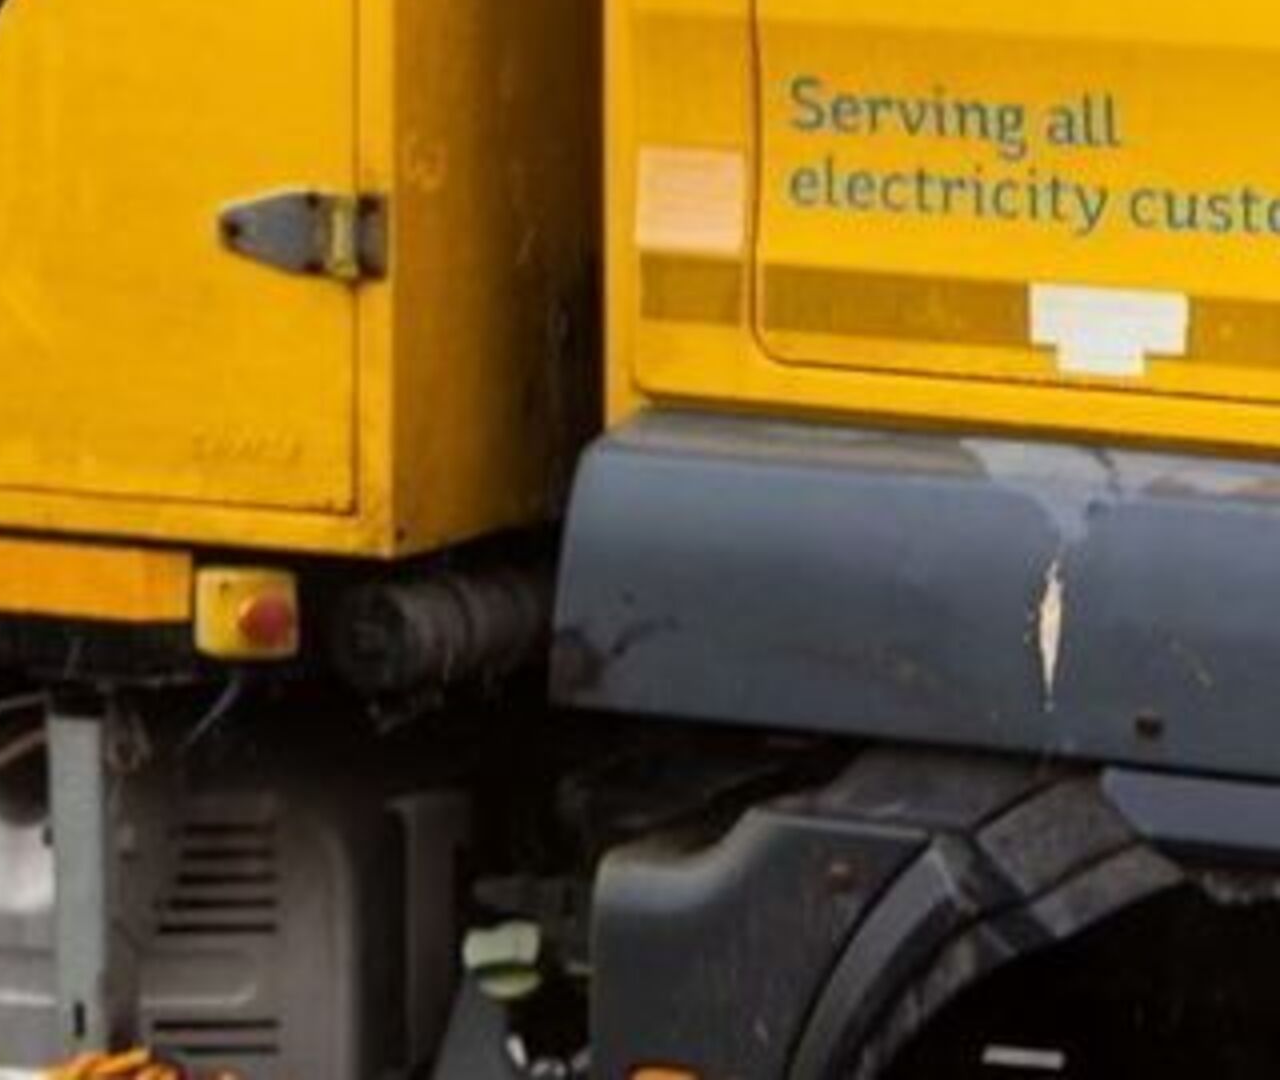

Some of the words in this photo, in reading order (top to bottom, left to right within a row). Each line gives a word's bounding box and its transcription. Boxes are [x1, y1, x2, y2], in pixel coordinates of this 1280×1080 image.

[790, 76, 1027, 160] Serving
[1046, 92, 1121, 148] all
[789, 156, 1108, 235] electricity
